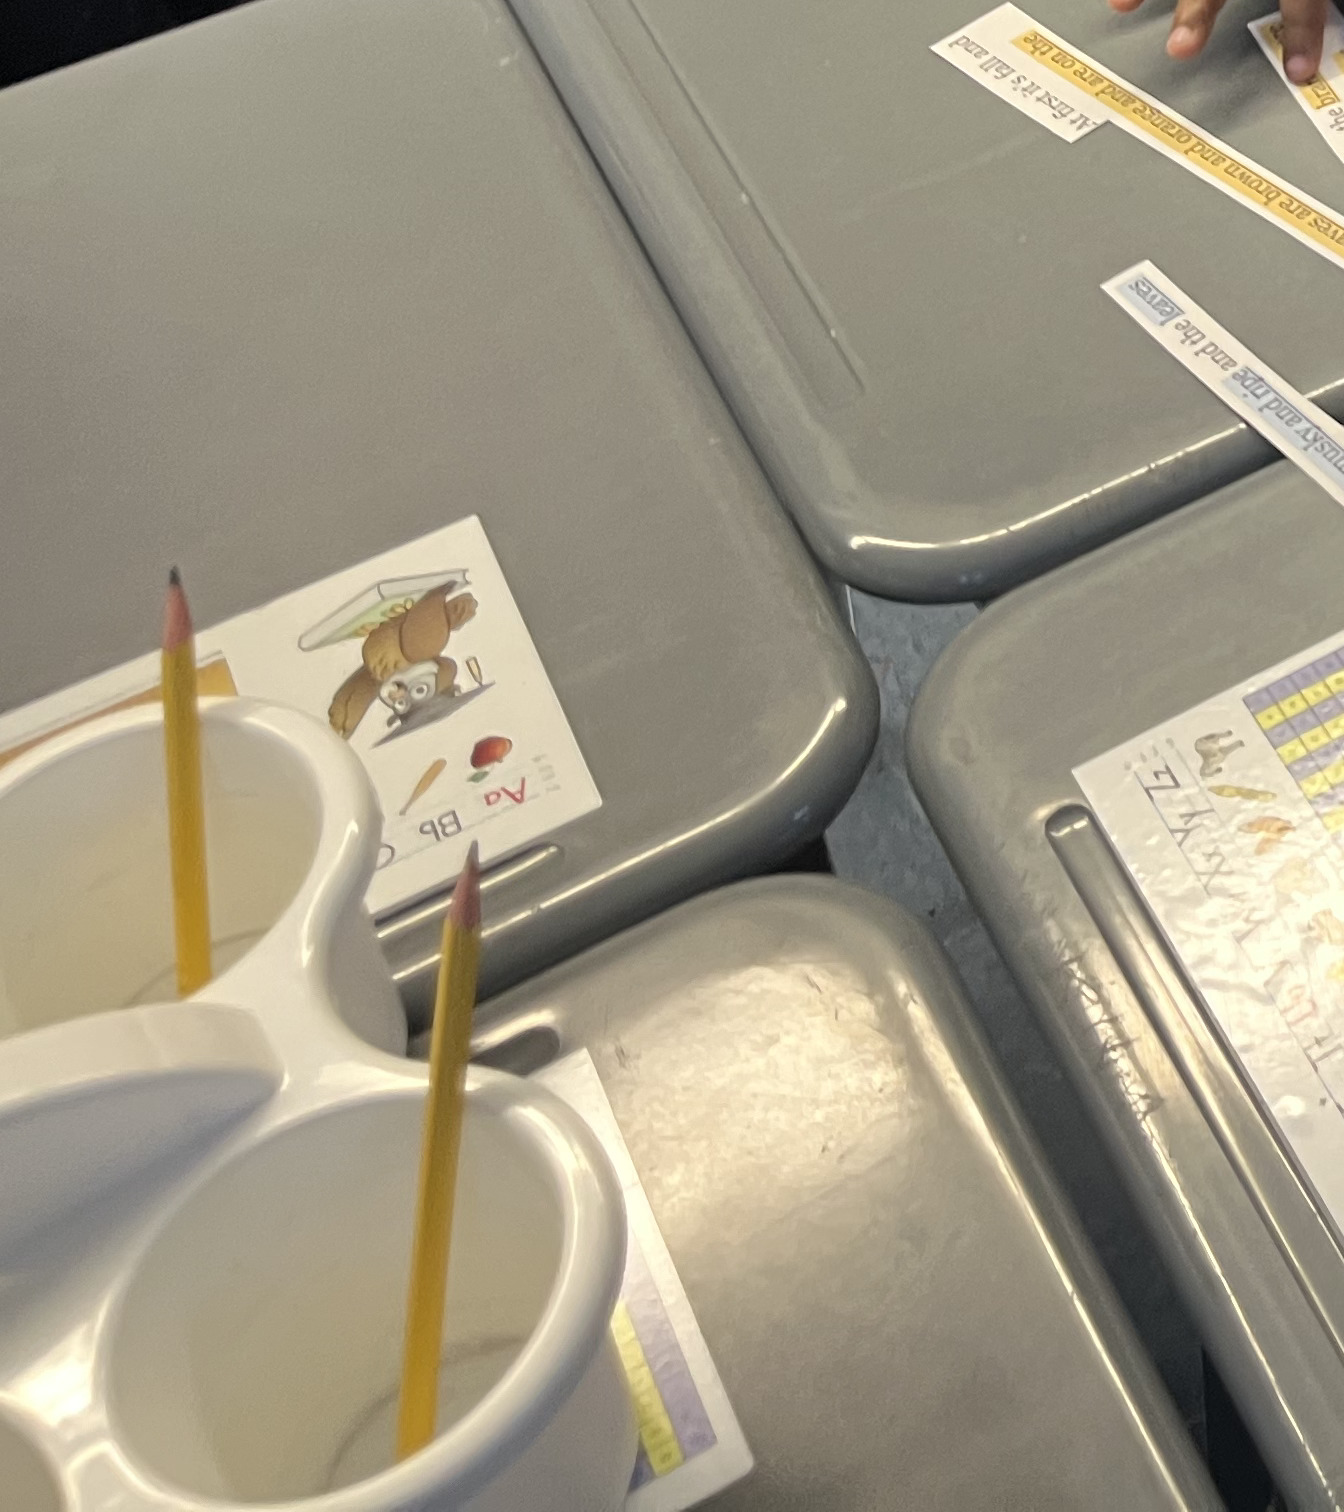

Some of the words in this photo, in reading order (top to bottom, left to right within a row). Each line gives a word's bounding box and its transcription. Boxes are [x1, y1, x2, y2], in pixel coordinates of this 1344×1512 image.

[947, 33, 989, 58] and
[1018, 32, 1053, 59] the
[1049, 50, 1076, 71] on
[978, 55, 1015, 81] fall
[1072, 64, 1104, 87] are
[1034, 90, 1074, 120] first
[1093, 81, 1136, 109] and
[1069, 112, 1098, 130] At
[1131, 99, 1192, 145] orange
[1183, 139, 1227, 170] and
[1221, 161, 1281, 206] brown
[1277, 195, 1311, 221] are
[1126, 277, 1181, 325] leaves
[1169, 316, 1206, 352] the
[1193, 340, 1238, 372] and
[1230, 368, 1270, 402] ripe
[1255, 395, 1302, 426] and
[484, 777, 526, 806] Aa
[1145, 764, 1181, 801] Zz
[419, 810, 462, 841] Bb
[1170, 808, 1215, 848] Yy
